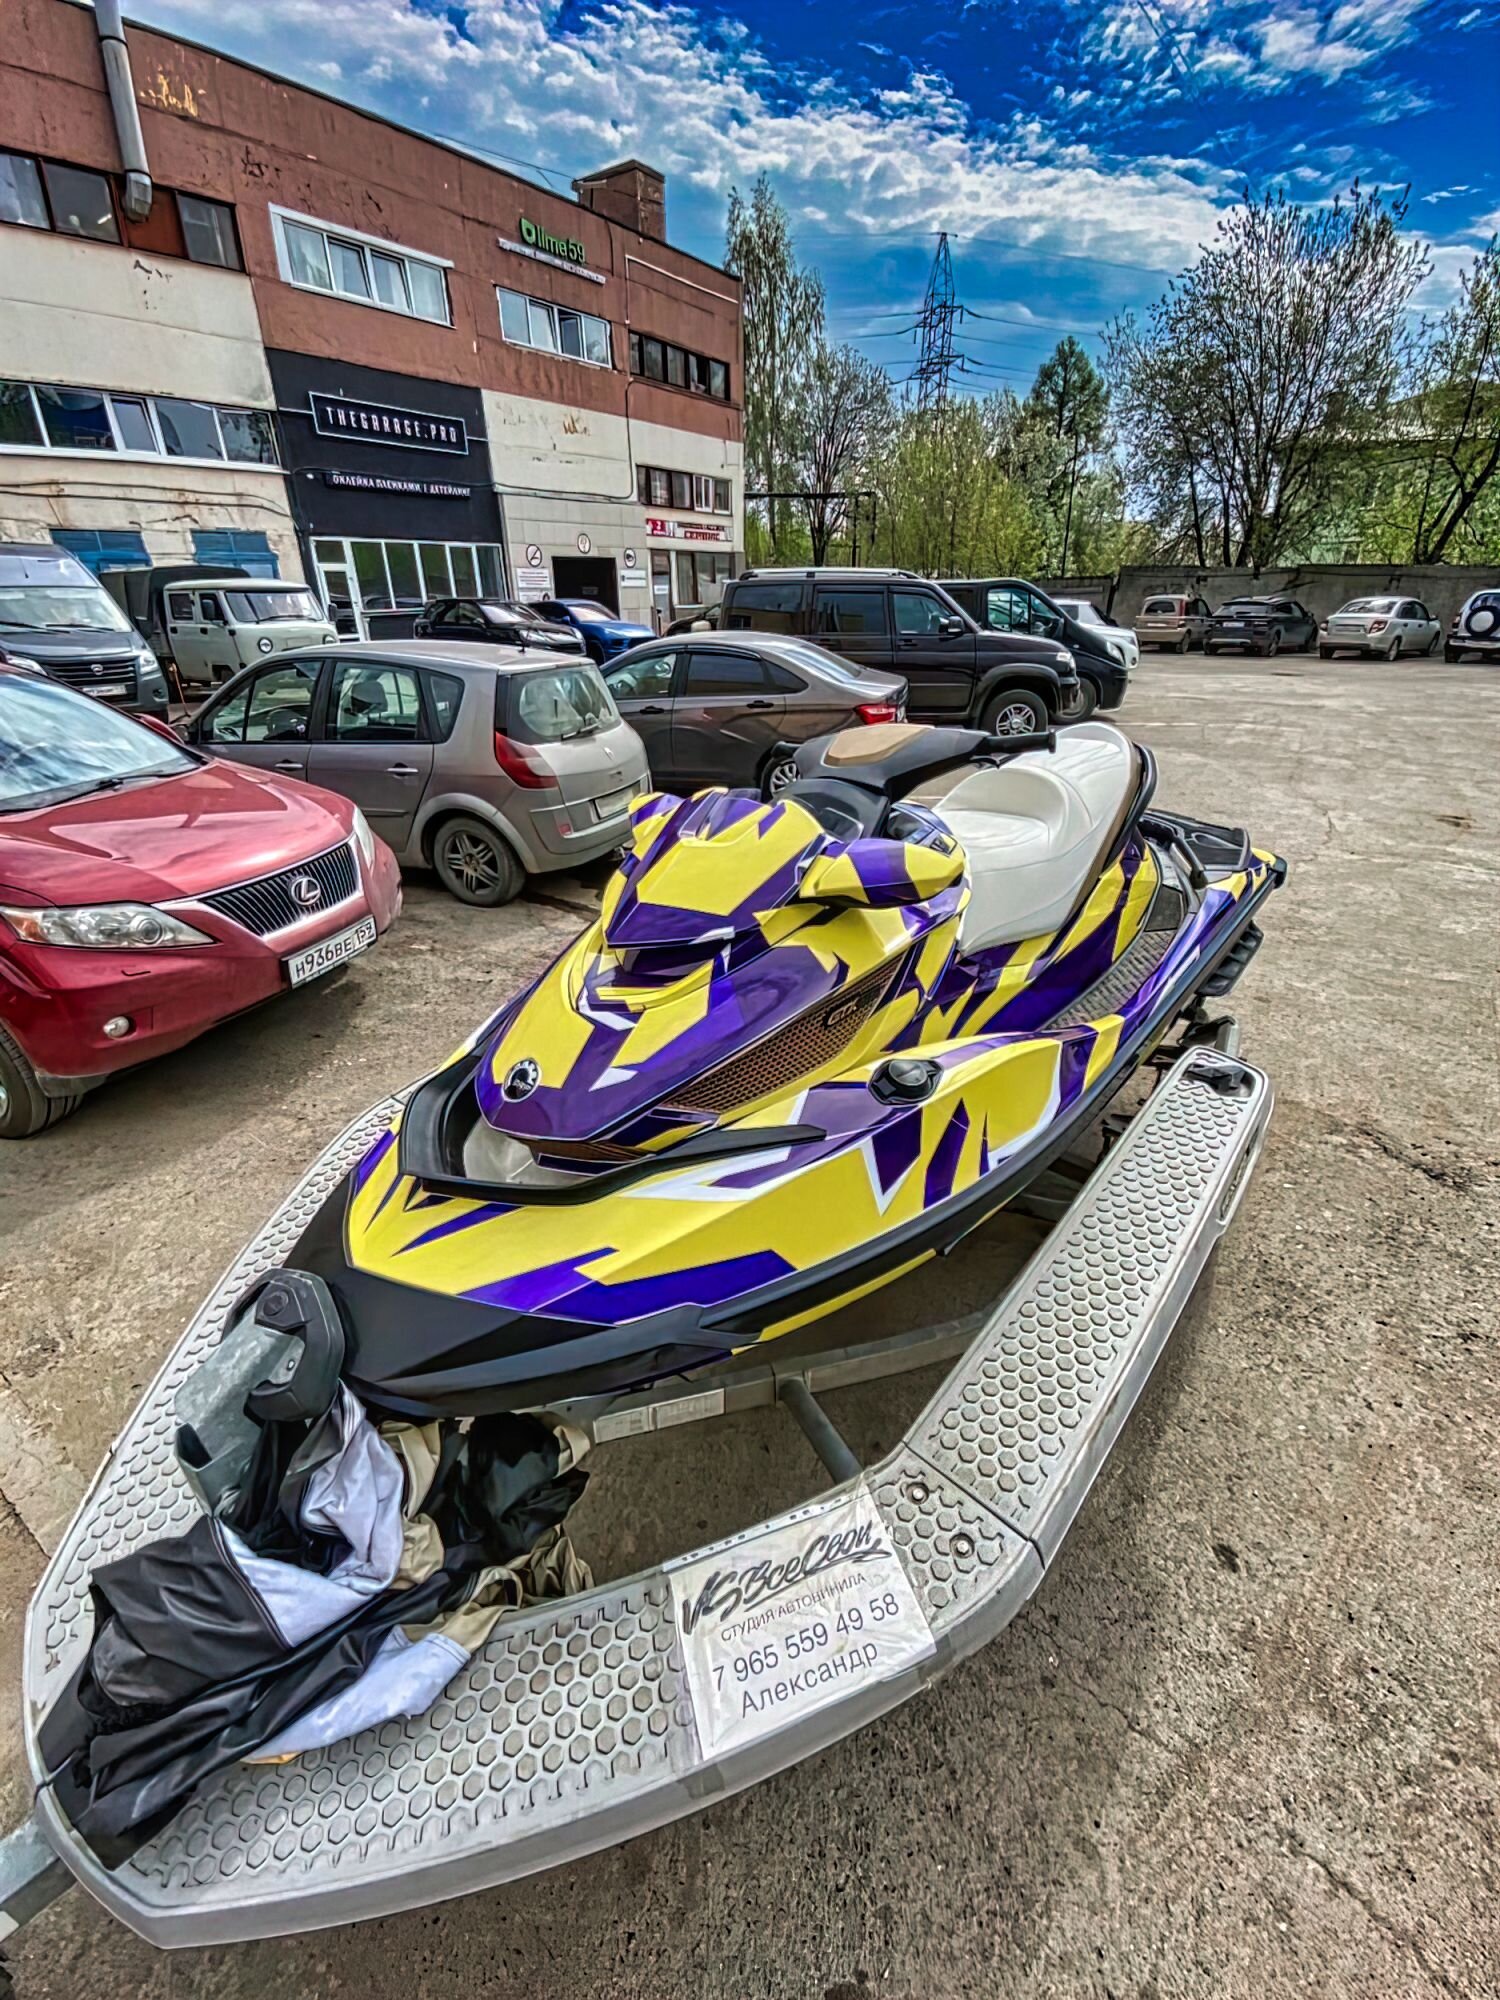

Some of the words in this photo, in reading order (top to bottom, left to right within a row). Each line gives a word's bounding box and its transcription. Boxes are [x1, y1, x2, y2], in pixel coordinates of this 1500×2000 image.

[711, 1665, 726, 1692] 7
[733, 1643, 779, 1683] 965
[784, 1622, 829, 1660] 559
[835, 1606, 864, 1639] 49
[869, 1592, 900, 1624] 58
[721, 1608, 776, 1642] СТУДИЯ
[778, 1572, 867, 1617] АВТОВИНИЛА
[741, 1642, 879, 1719] Александр
